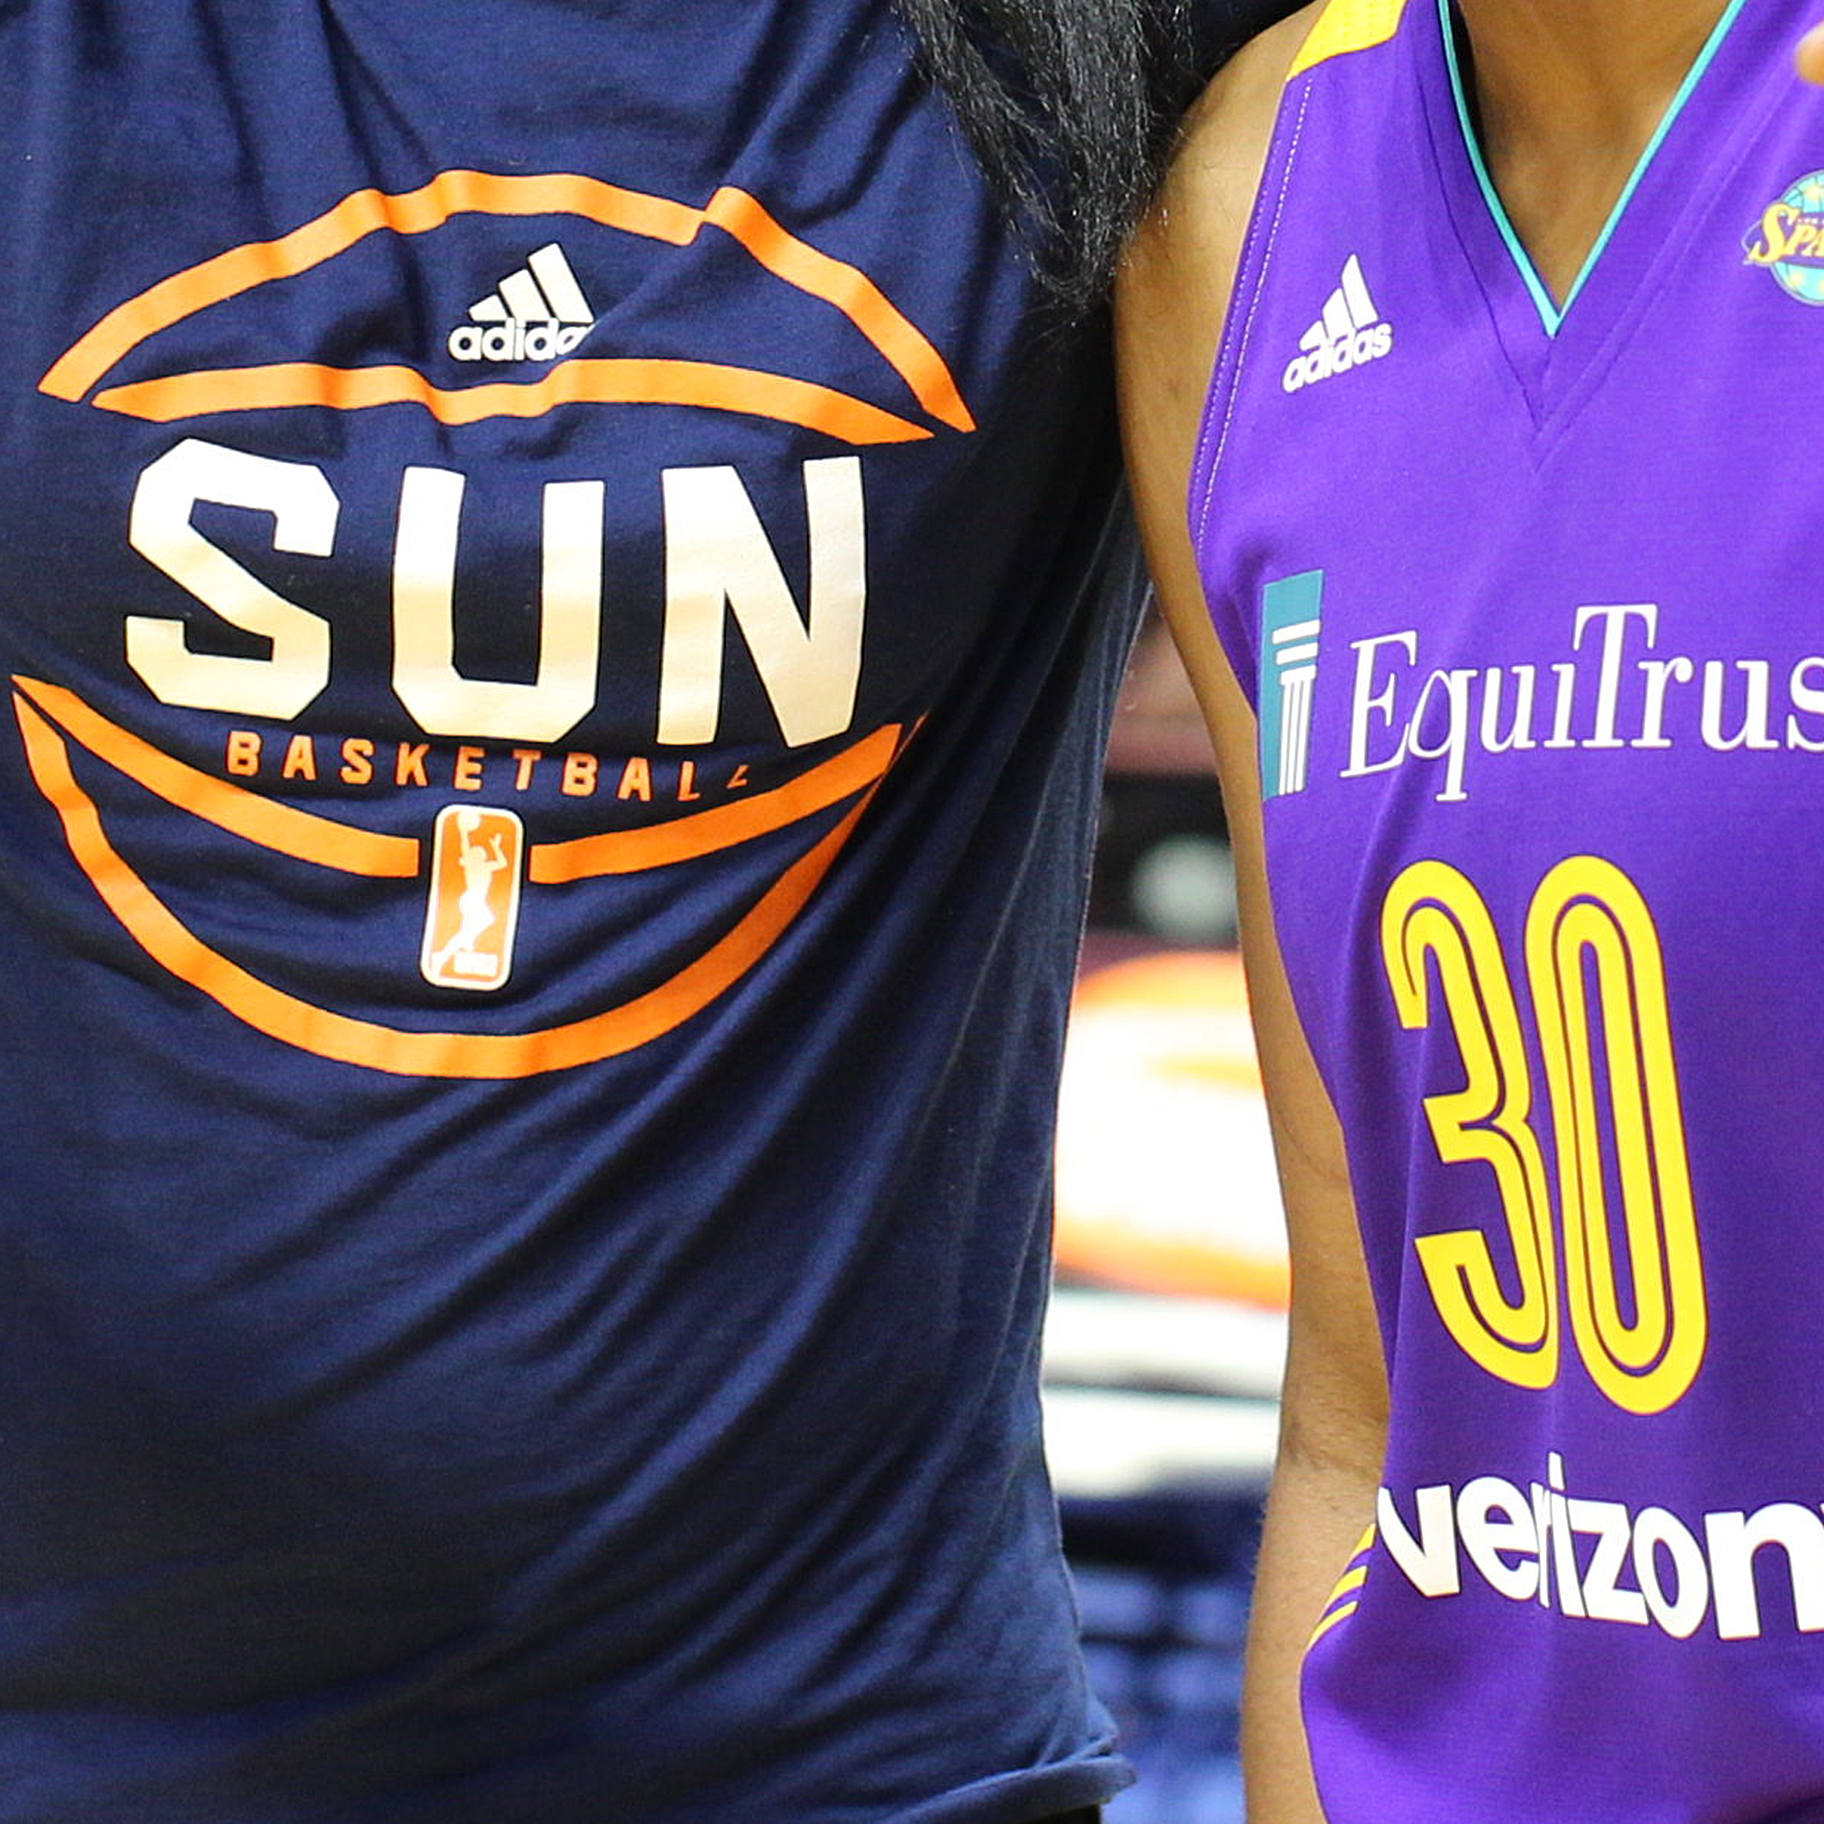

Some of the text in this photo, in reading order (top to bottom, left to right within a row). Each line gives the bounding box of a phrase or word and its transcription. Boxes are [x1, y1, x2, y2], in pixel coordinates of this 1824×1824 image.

[448, 317, 595, 361] adida
[1282, 322, 1393, 393] adidas
[125, 438, 866, 748] SUN
[1381, 855, 1707, 1414] 30
